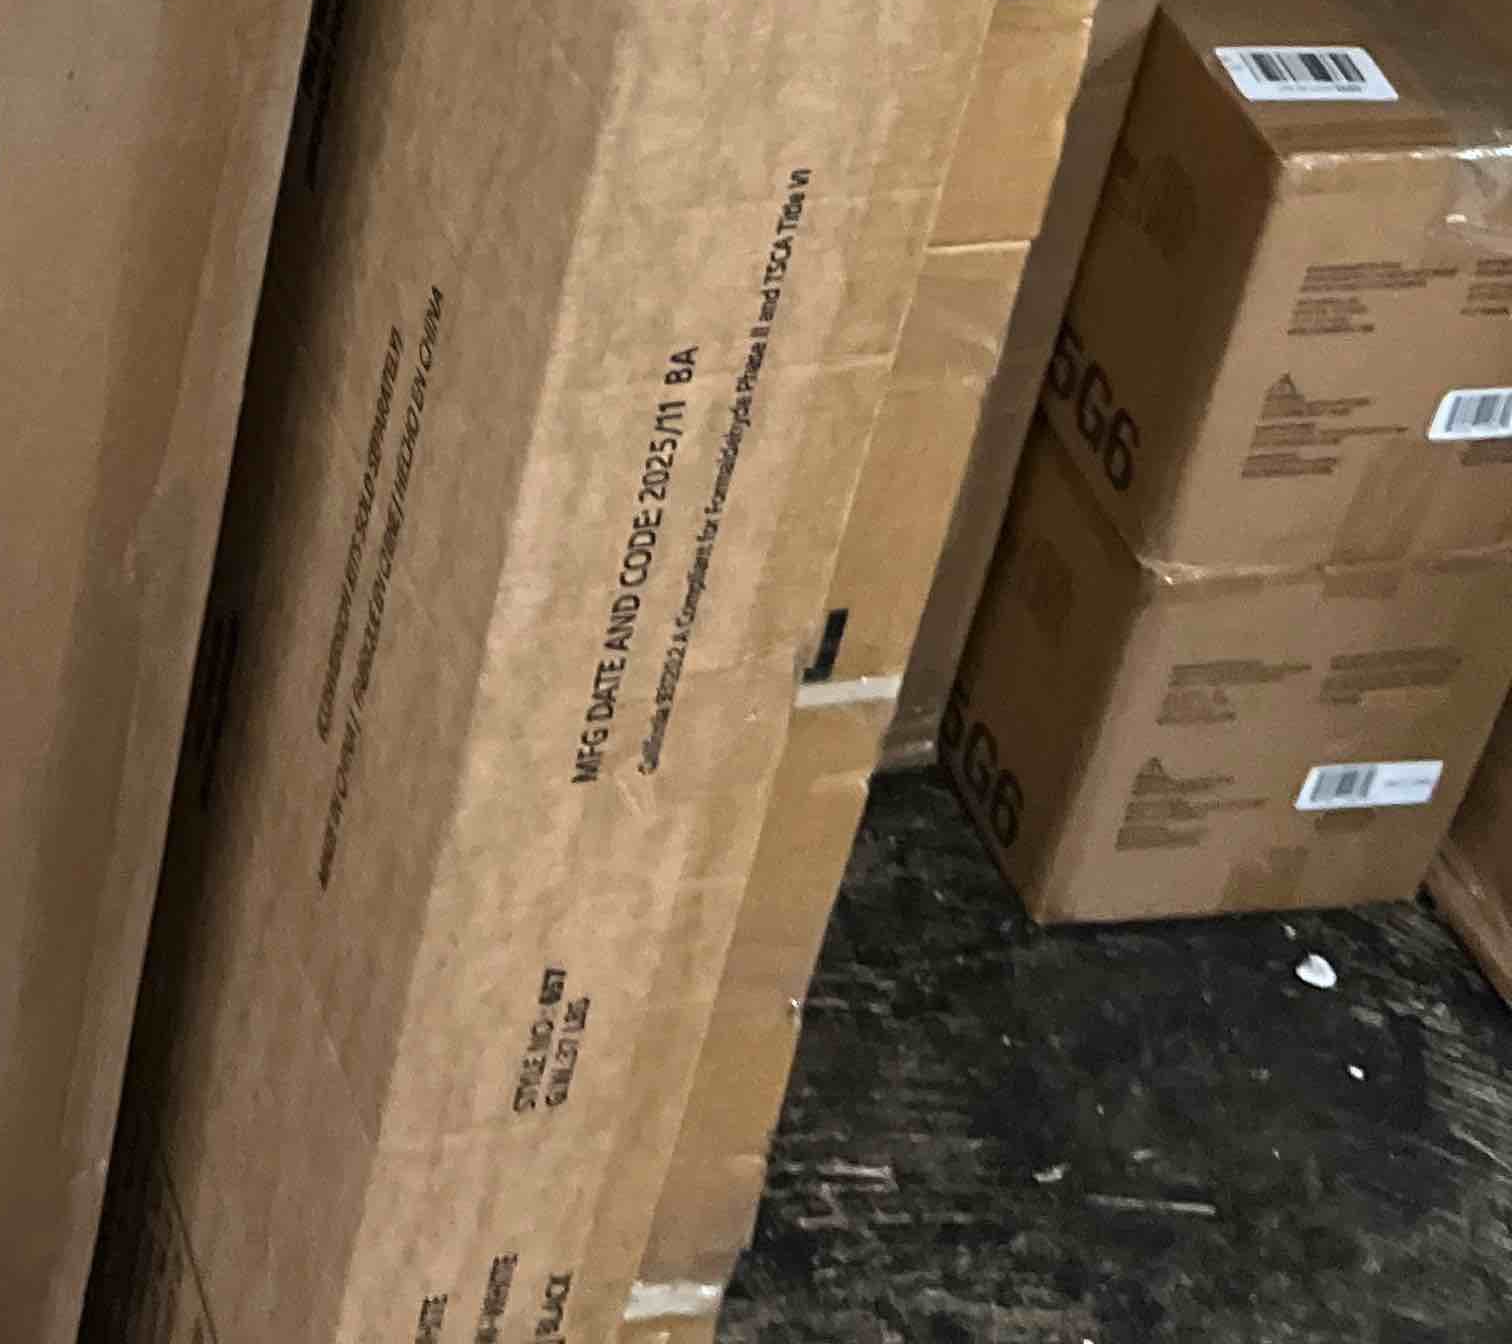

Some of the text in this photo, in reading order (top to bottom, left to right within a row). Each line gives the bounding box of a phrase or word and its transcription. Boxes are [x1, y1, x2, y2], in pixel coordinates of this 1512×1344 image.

[761, 232, 794, 289] TSCA
[752, 285, 780, 322] and
[569, 340, 699, 788] MFG DATE AND CODE 2025/11 BA
